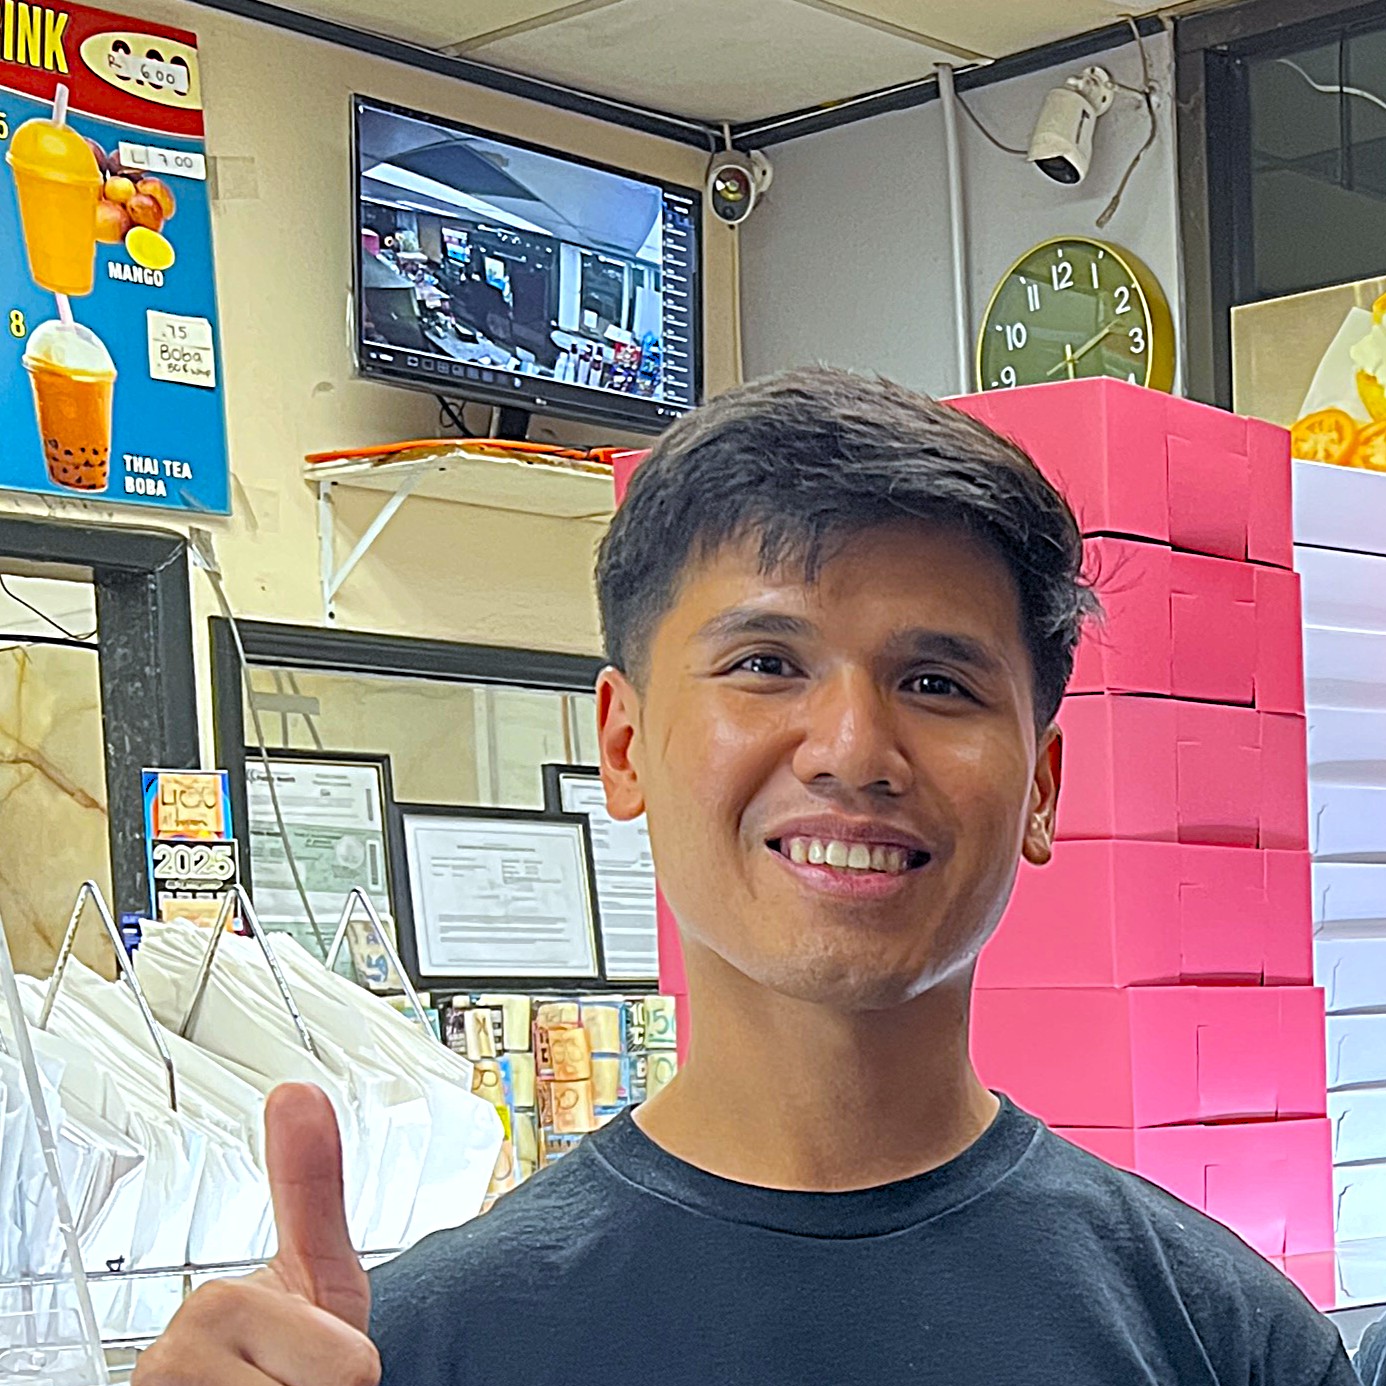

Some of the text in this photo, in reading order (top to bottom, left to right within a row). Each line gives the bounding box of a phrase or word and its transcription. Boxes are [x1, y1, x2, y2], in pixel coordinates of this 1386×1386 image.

[107, 260, 165, 288] MANGO
[1051, 261, 1074, 291] 12
[1090, 261, 1099, 289] 1
[1026, 283, 1041, 312] 11
[1113, 285, 1132, 315] 2
[9, 309, 27, 339] 8
[1005, 321, 1028, 351] 10
[1127, 326, 1146, 354] 3
[1000, 365, 1017, 388] 9
[122, 453, 193, 480] THAI TEA
[123, 475, 168, 498] BOBA
[153, 843, 236, 881] 2025
